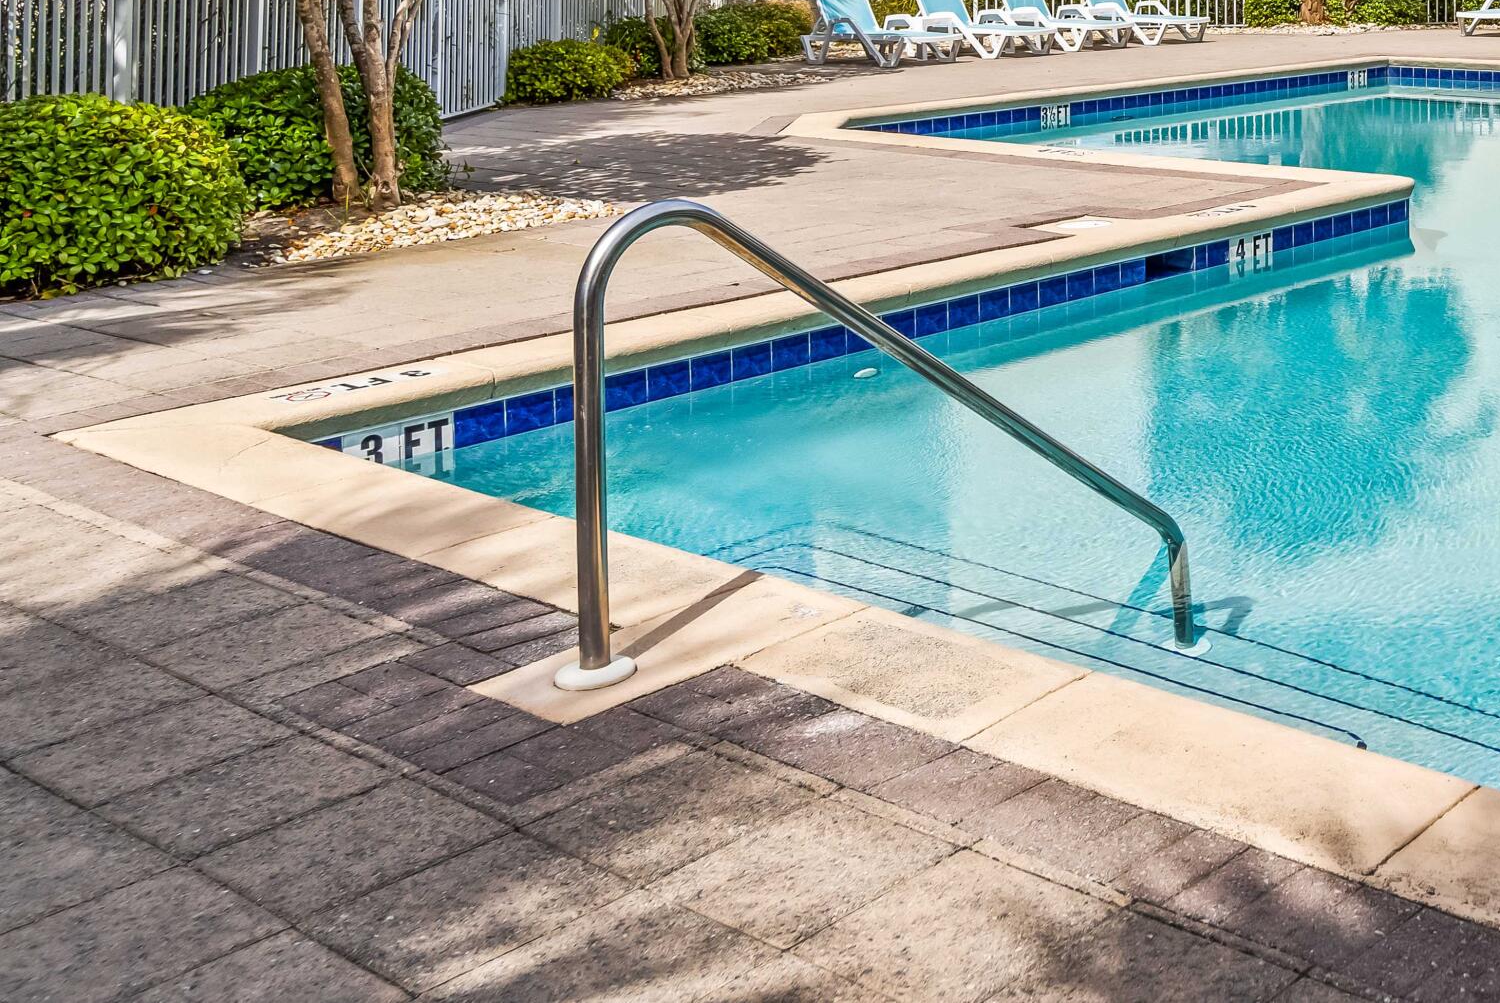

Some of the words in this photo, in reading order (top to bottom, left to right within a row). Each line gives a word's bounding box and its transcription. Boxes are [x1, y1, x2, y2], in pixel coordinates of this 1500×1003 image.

[1236, 238, 1245, 260] 4
[360, 434, 384, 464] 3
[404, 418, 450, 460] FT.
